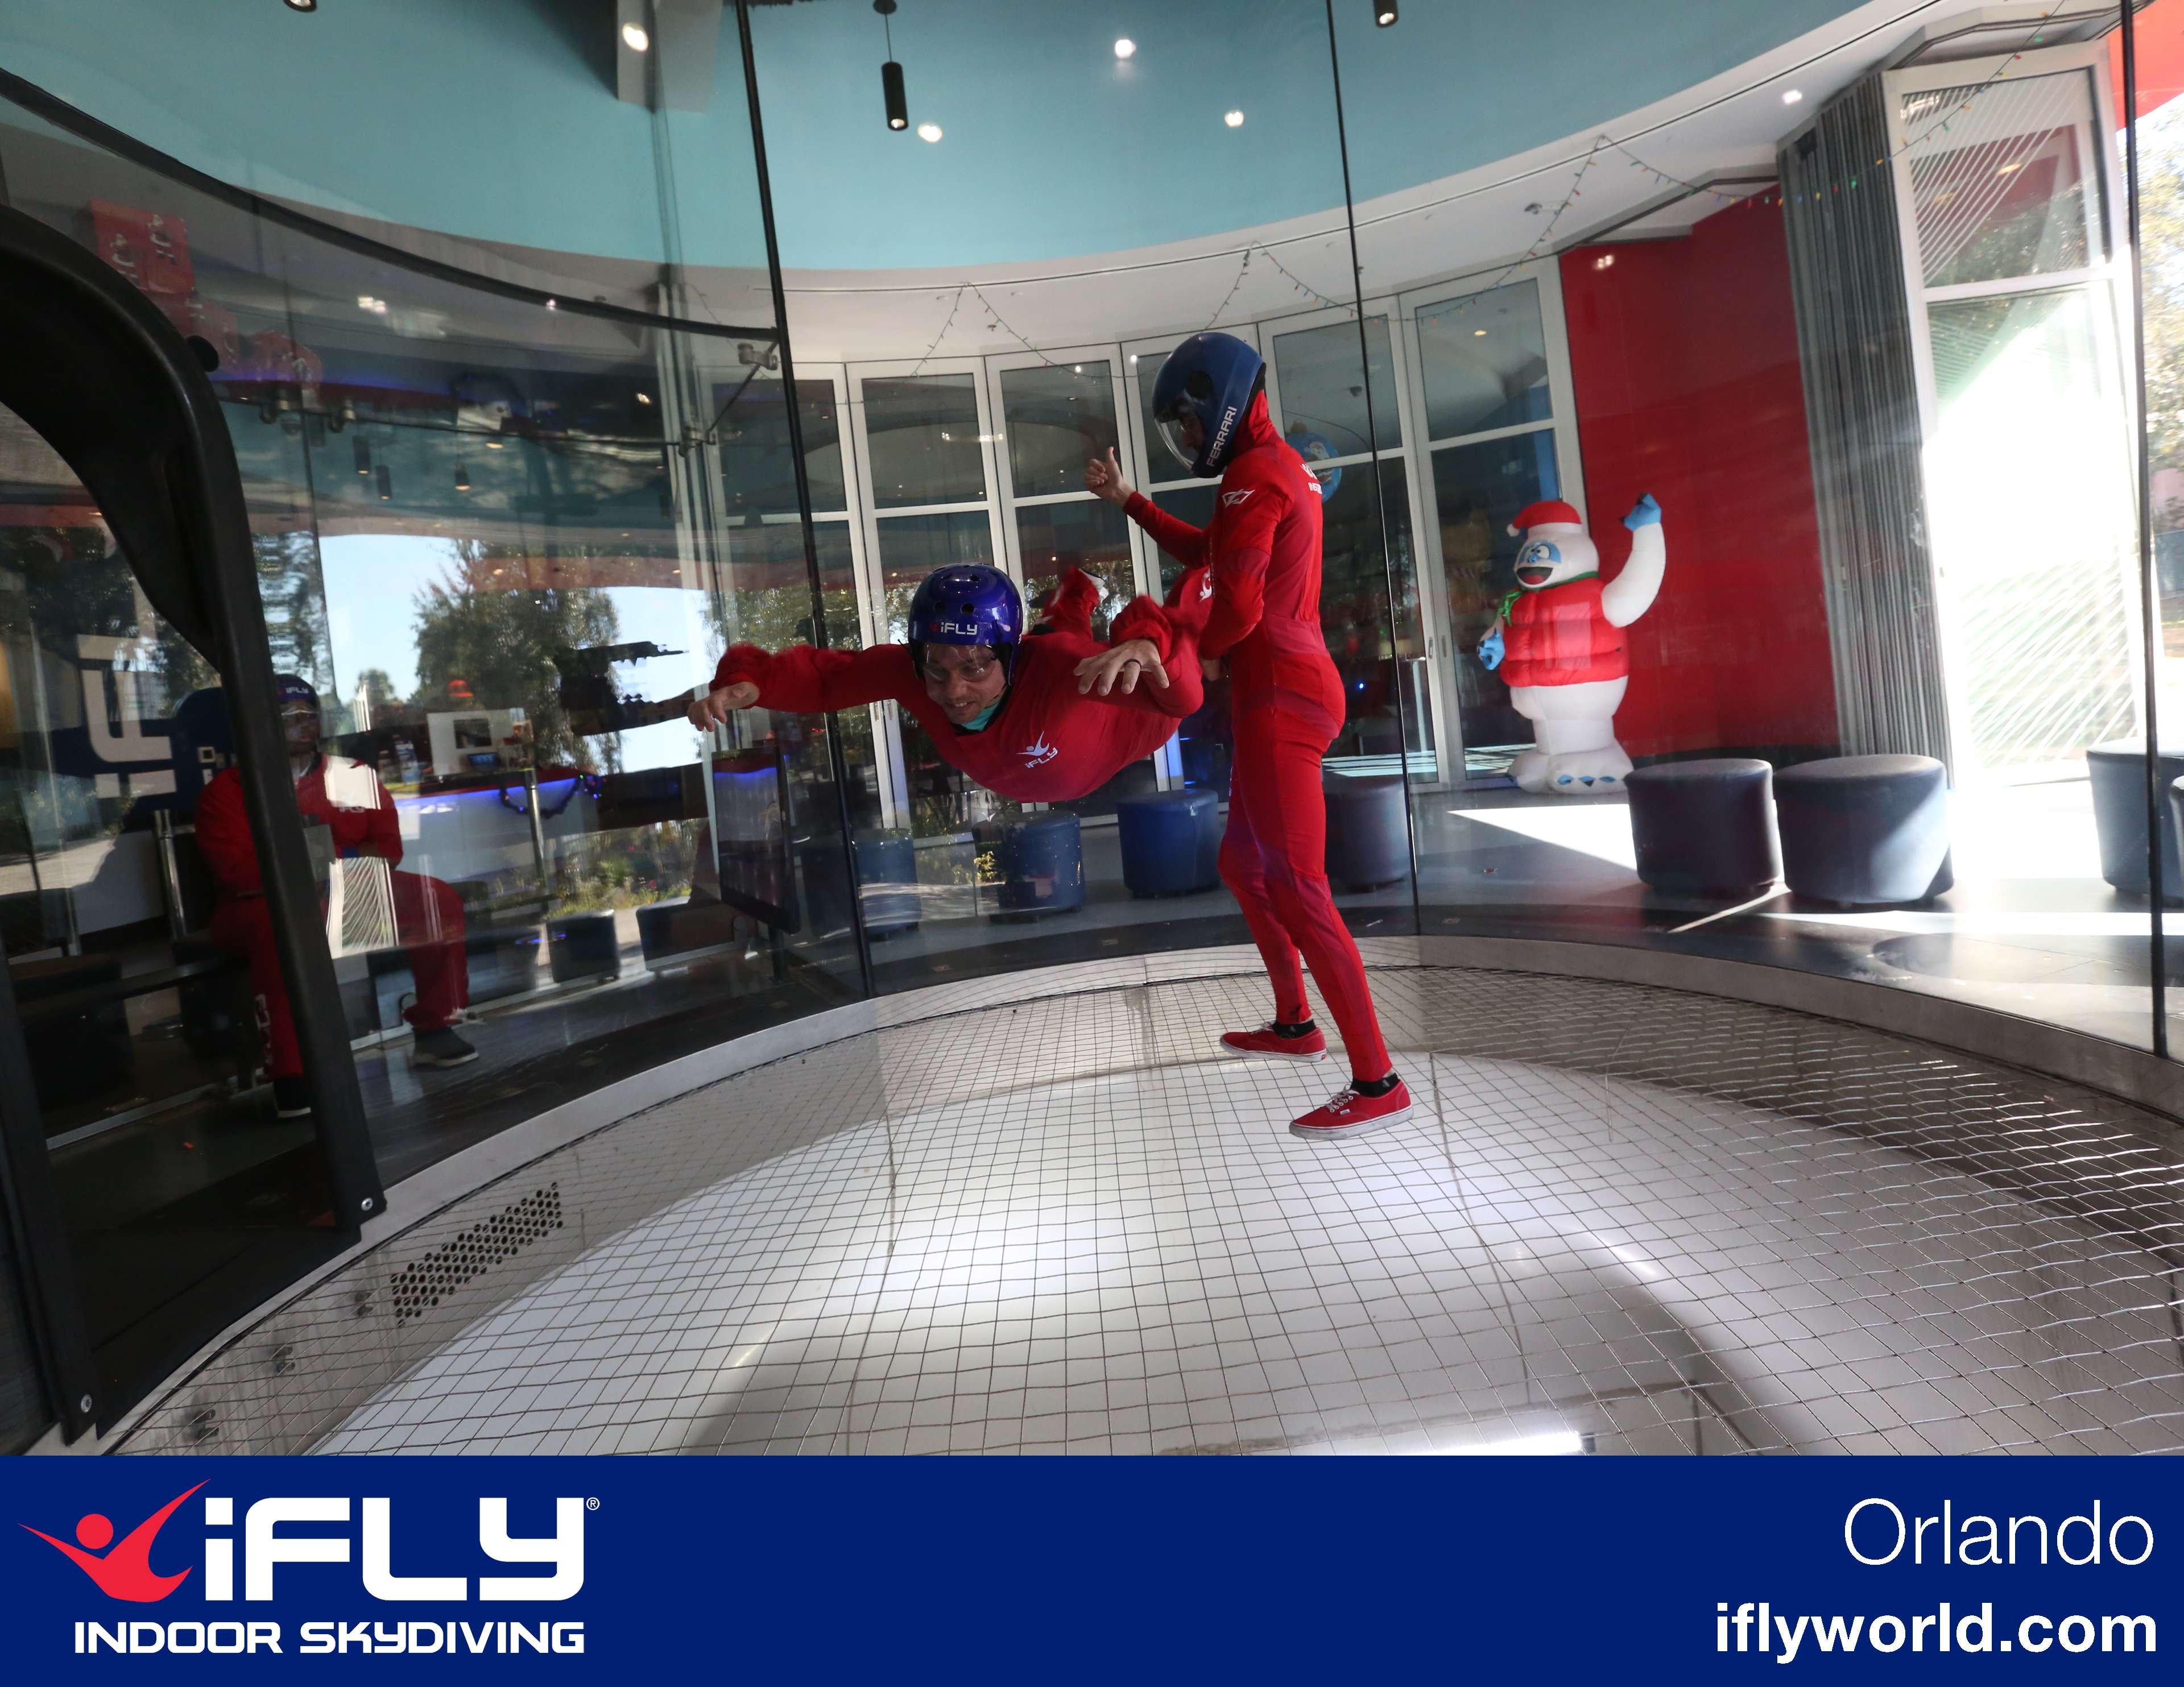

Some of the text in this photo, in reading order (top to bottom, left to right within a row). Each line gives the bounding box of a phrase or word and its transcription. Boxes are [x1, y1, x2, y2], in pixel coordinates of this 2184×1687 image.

[1206, 405, 1238, 466] FERRARI
[941, 622, 978, 635] iFLY
[1025, 747, 1058, 768] iFLY
